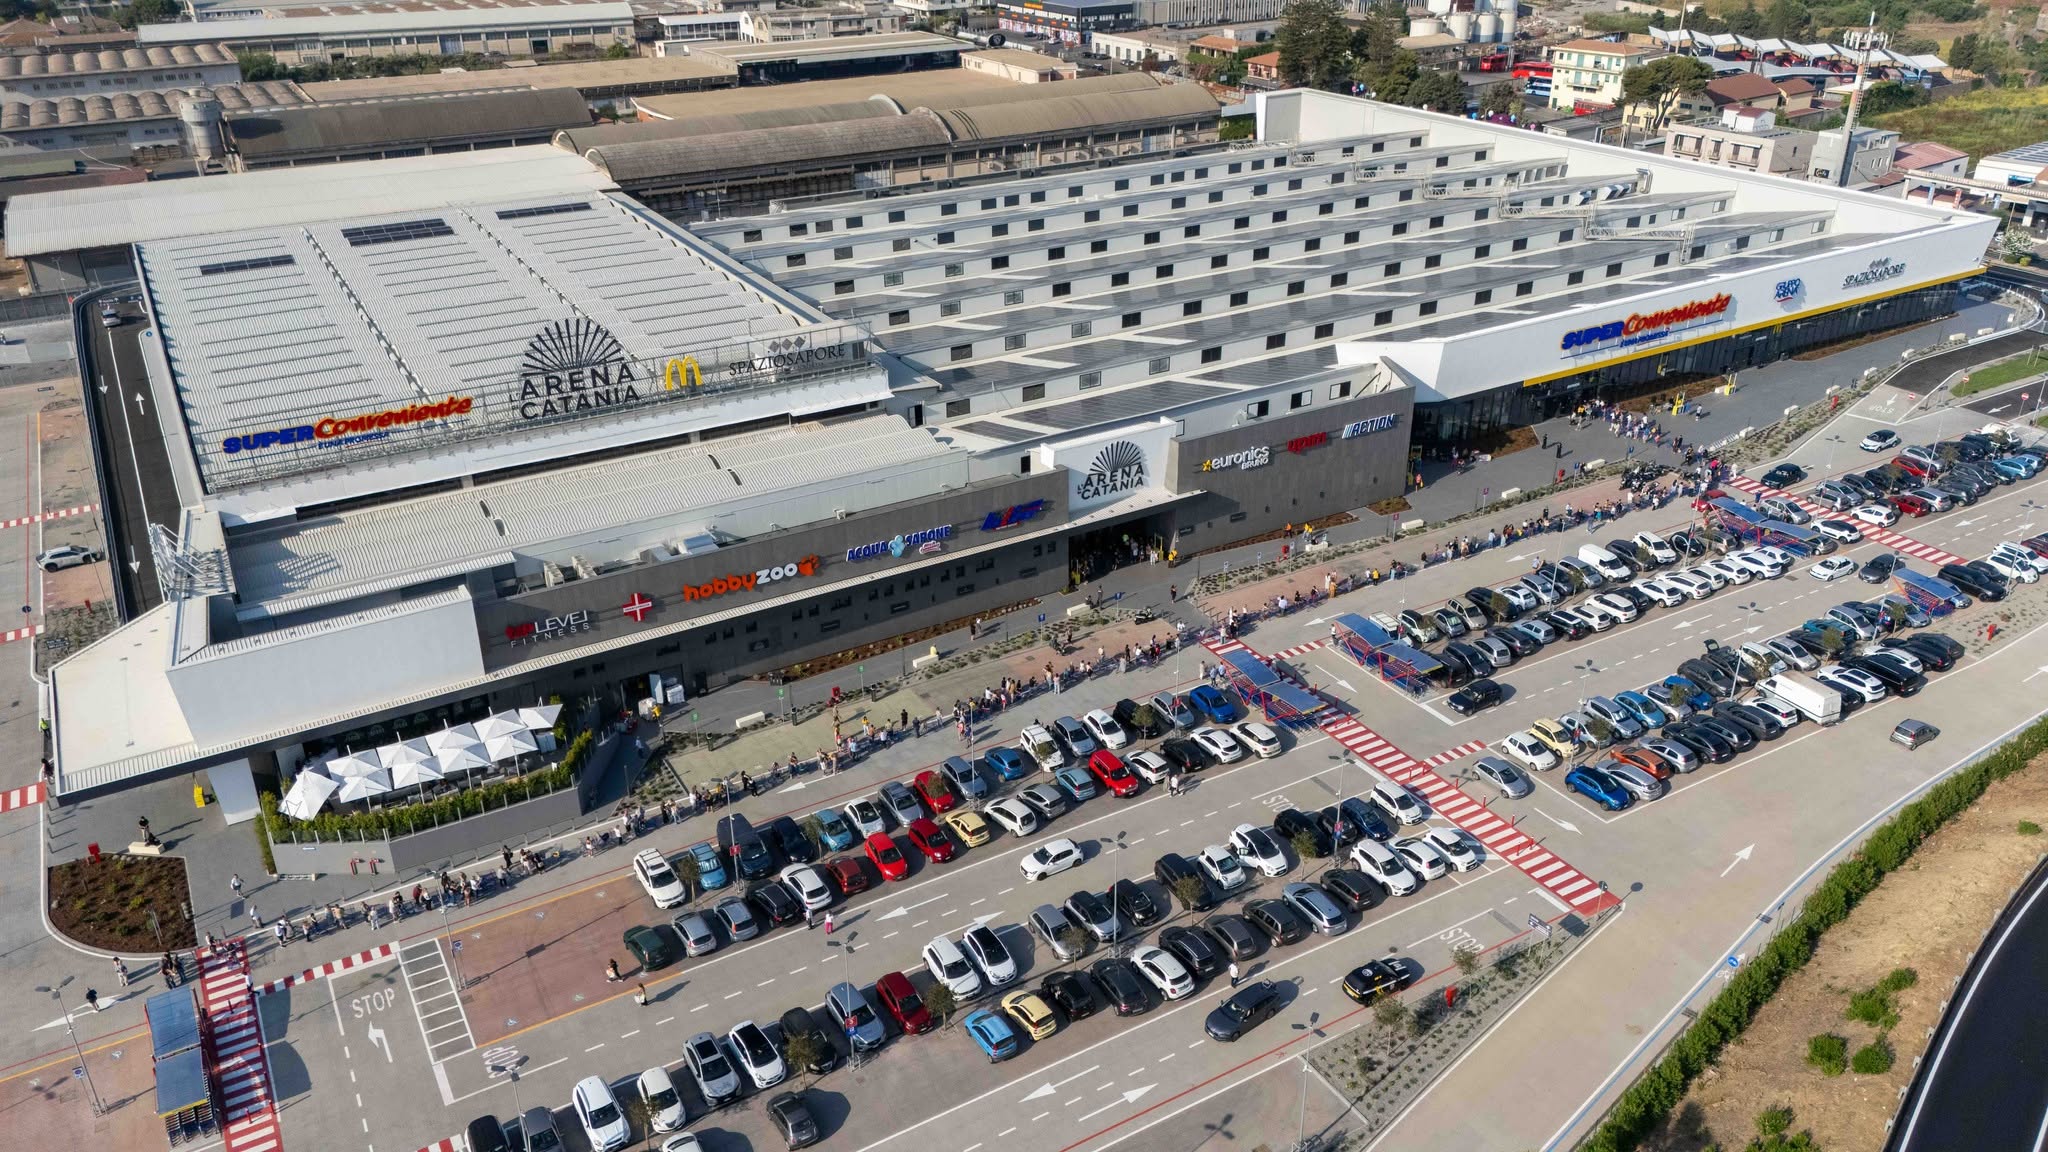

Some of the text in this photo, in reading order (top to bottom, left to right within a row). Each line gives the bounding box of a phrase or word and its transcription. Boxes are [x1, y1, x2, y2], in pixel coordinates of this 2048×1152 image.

[729, 344, 846, 376] SPAZIOSAPORE
[520, 385, 641, 420] CATANIA
[1349, 413, 1396, 437] ACTION
[1210, 445, 1270, 471] euronics
[1241, 456, 1269, 471] BRUNO
[1081, 476, 1144, 500] CATANIA
[845, 540, 890, 562] ACQUA
[510, 622, 590, 649] FITNESS
[351, 987, 396, 1019] STOP
